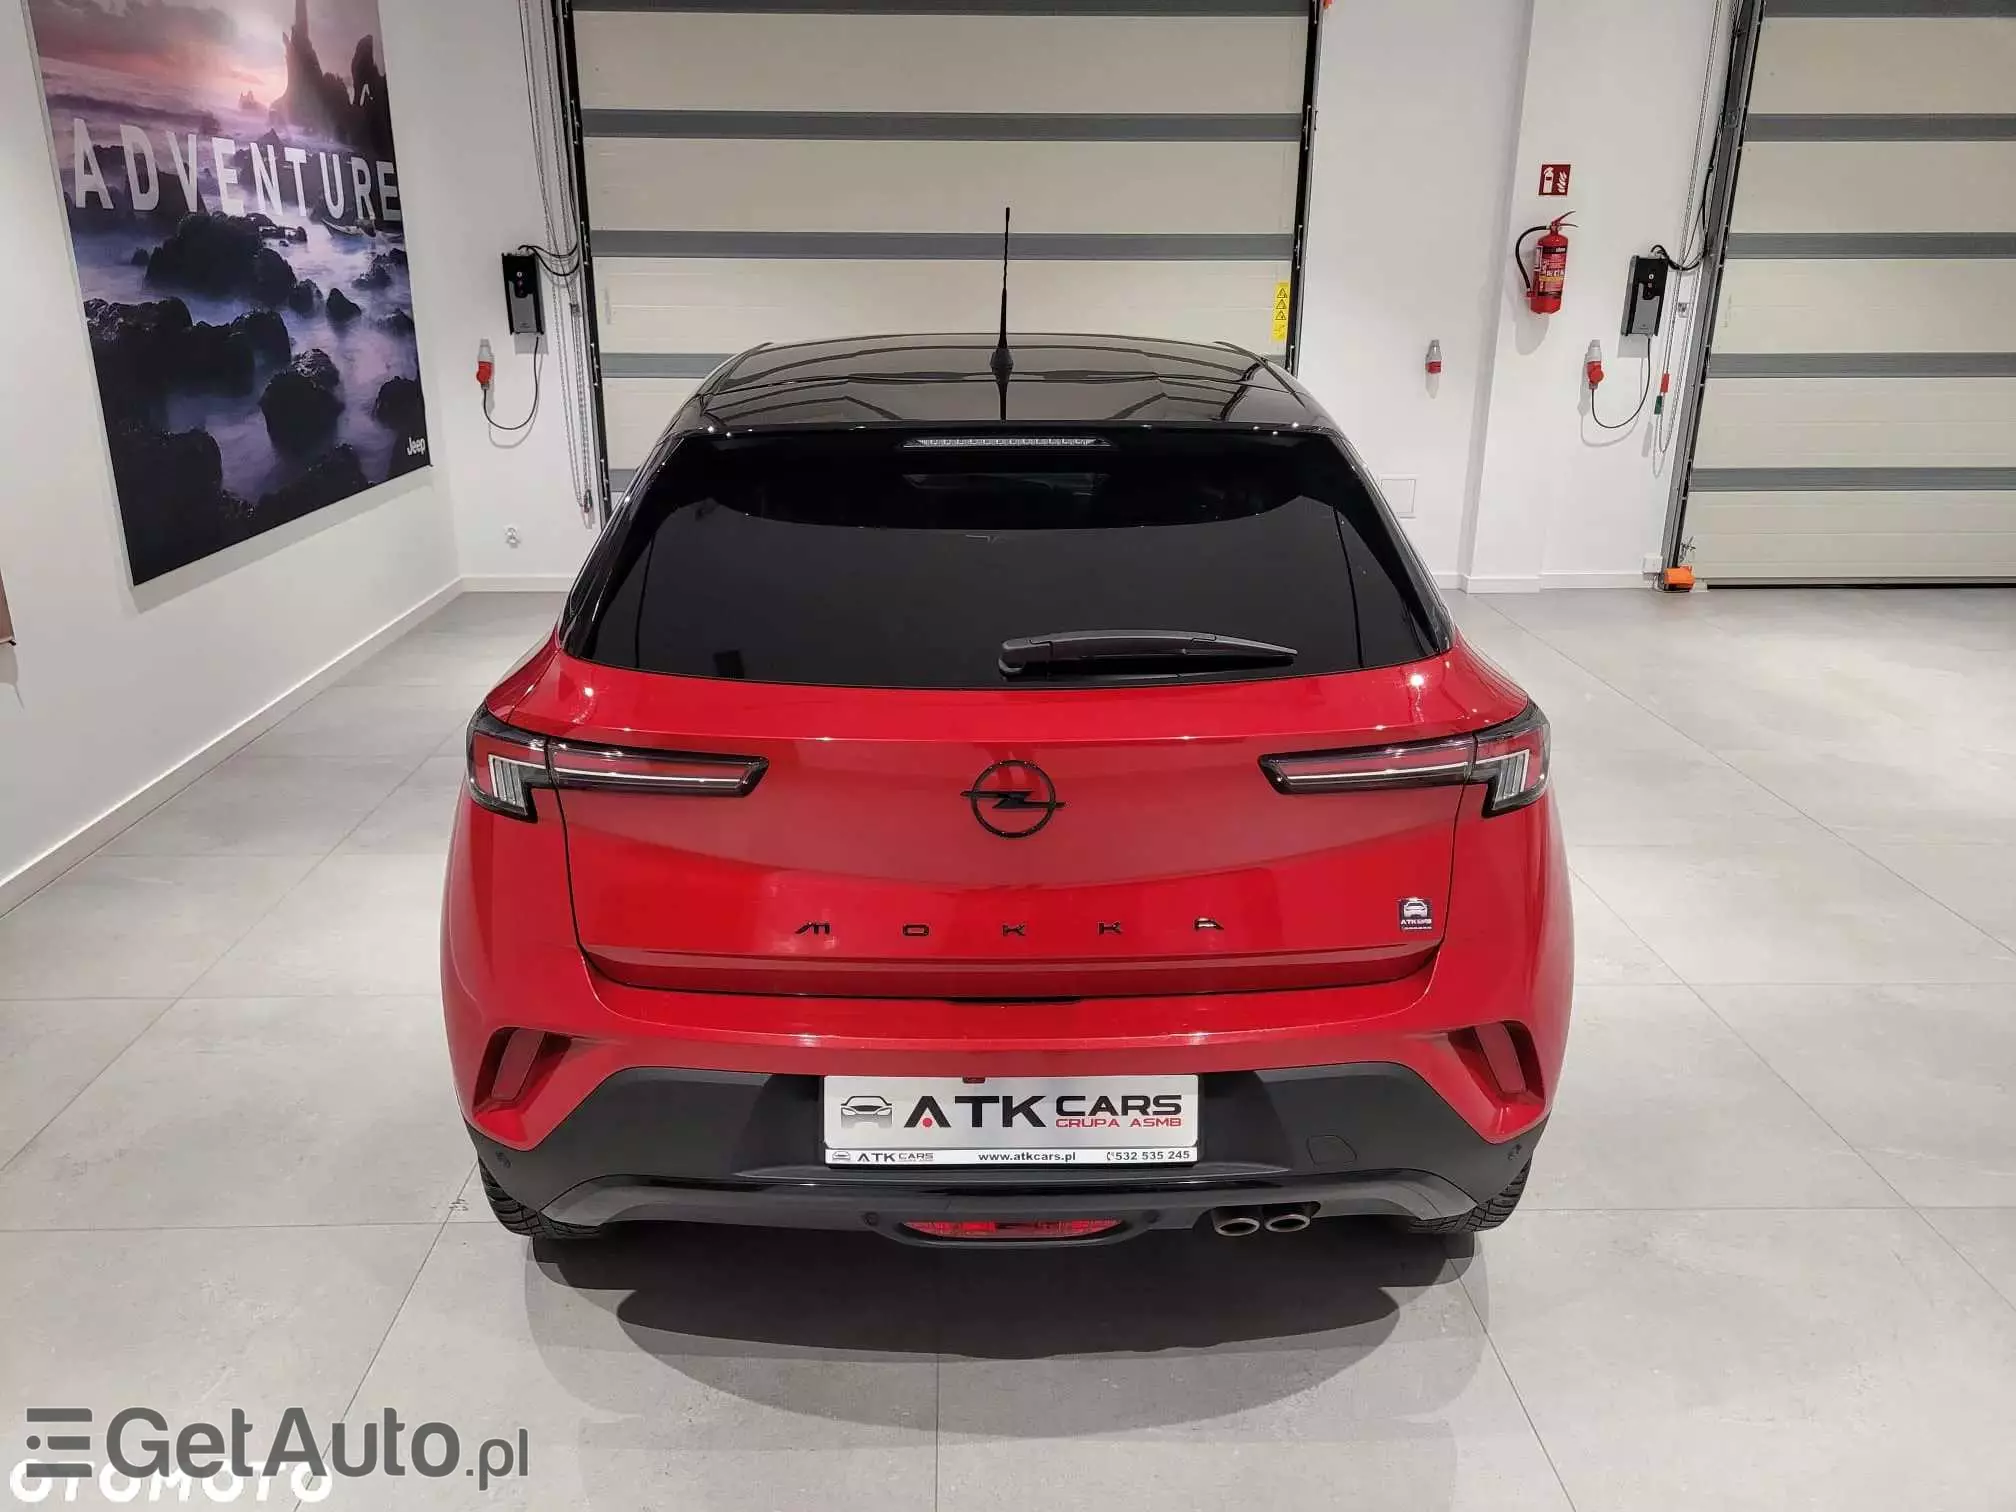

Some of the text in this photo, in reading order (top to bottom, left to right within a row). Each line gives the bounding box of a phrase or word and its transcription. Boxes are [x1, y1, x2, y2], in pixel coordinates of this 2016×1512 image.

[73, 118, 401, 222] ADVENTURE
[406, 436, 426, 456] Jeep
[795, 917, 1224, 937] MOKKA
[904, 1094, 1182, 1128] ATK CARS
[1055, 1117, 1182, 1128] GRUPA ASMB
[857, 1152, 934, 1163] ATK CARS
[978, 1151, 1076, 1163] www.atkcars.pl
[1114, 1150, 1190, 1161] 532 535 245
